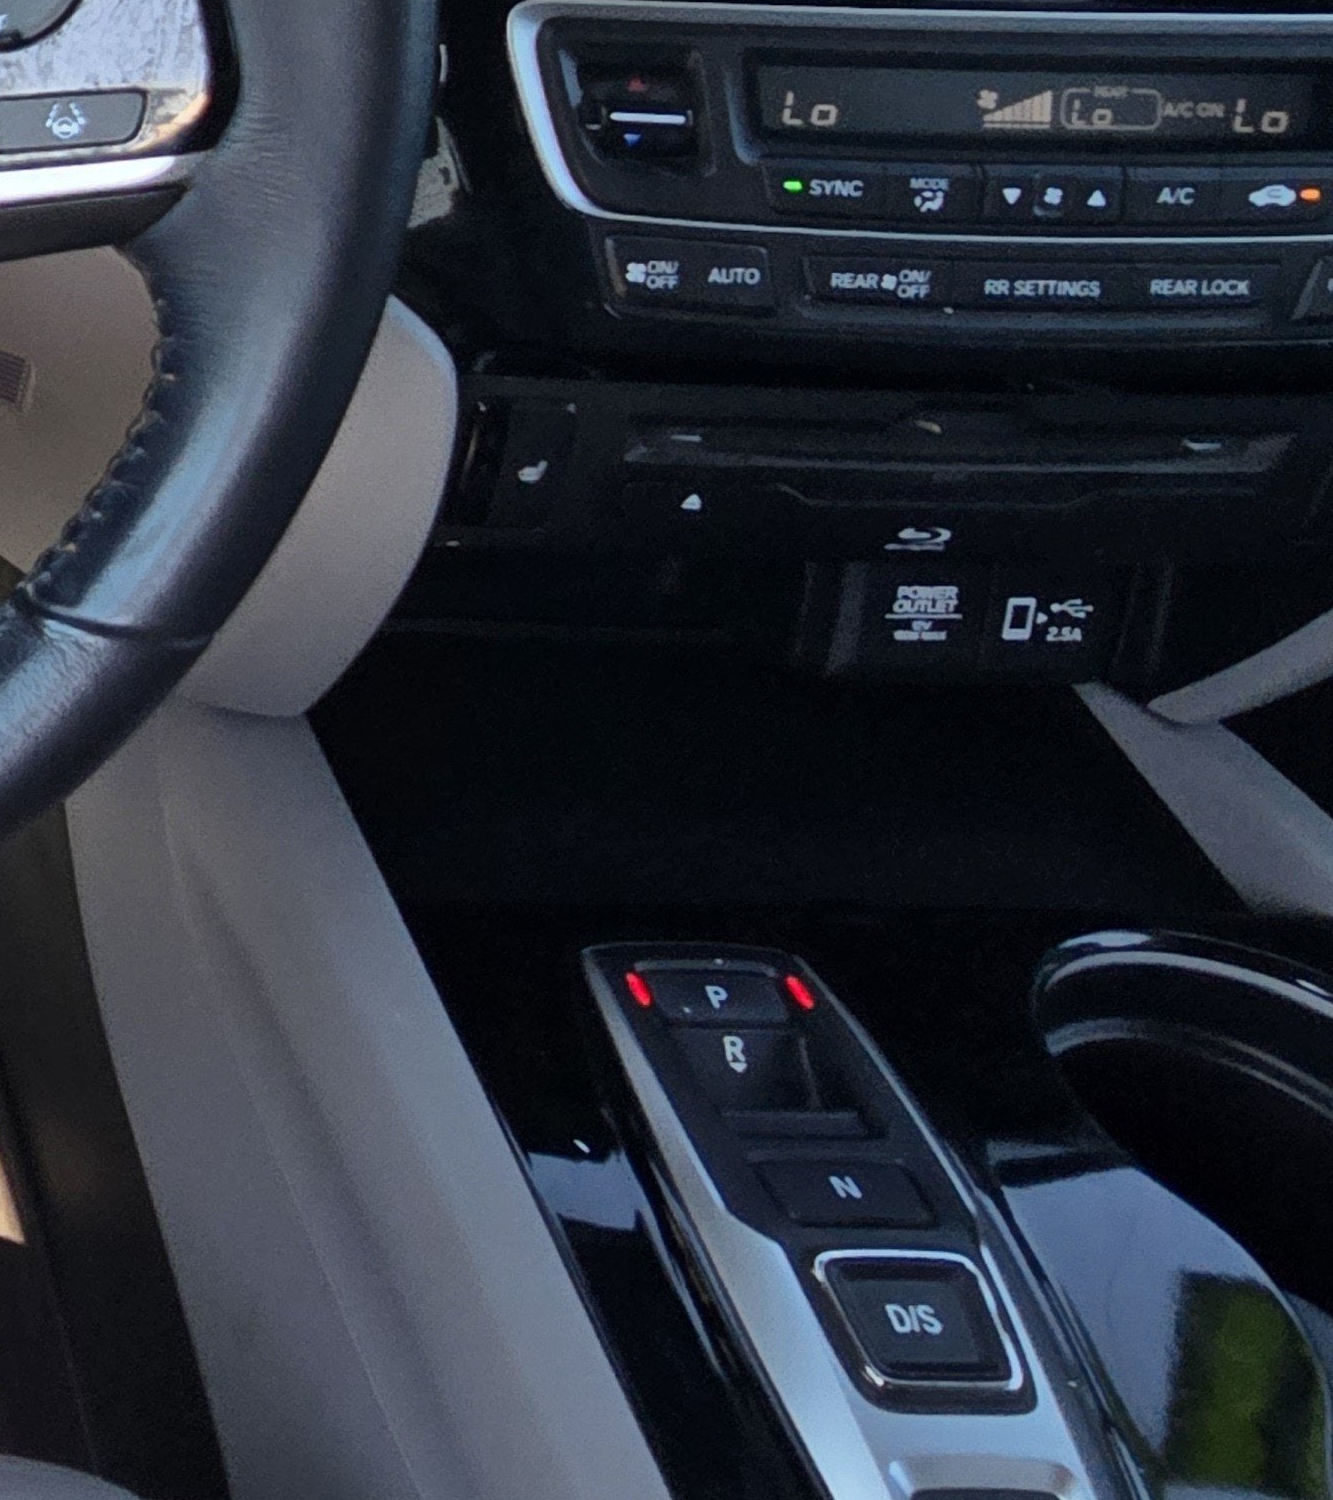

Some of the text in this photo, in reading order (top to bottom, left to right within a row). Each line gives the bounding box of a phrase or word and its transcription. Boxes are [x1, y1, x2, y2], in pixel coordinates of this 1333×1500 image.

[808, 179, 864, 198] SYNC
[909, 177, 950, 190] MODE
[1156, 187, 1196, 205] A/C
[645, 275, 679, 290] OFF
[707, 267, 761, 285] AUTO
[830, 272, 879, 290] REAR
[896, 284, 931, 299] OFF
[983, 278, 1101, 298] RR SETTINGS
[1149, 278, 1251, 296] REAR LOCK
[704, 985, 729, 1009] P
[723, 1035, 746, 1062] R
[828, 1174, 863, 1200] N
[884, 1303, 943, 1336] D/S
